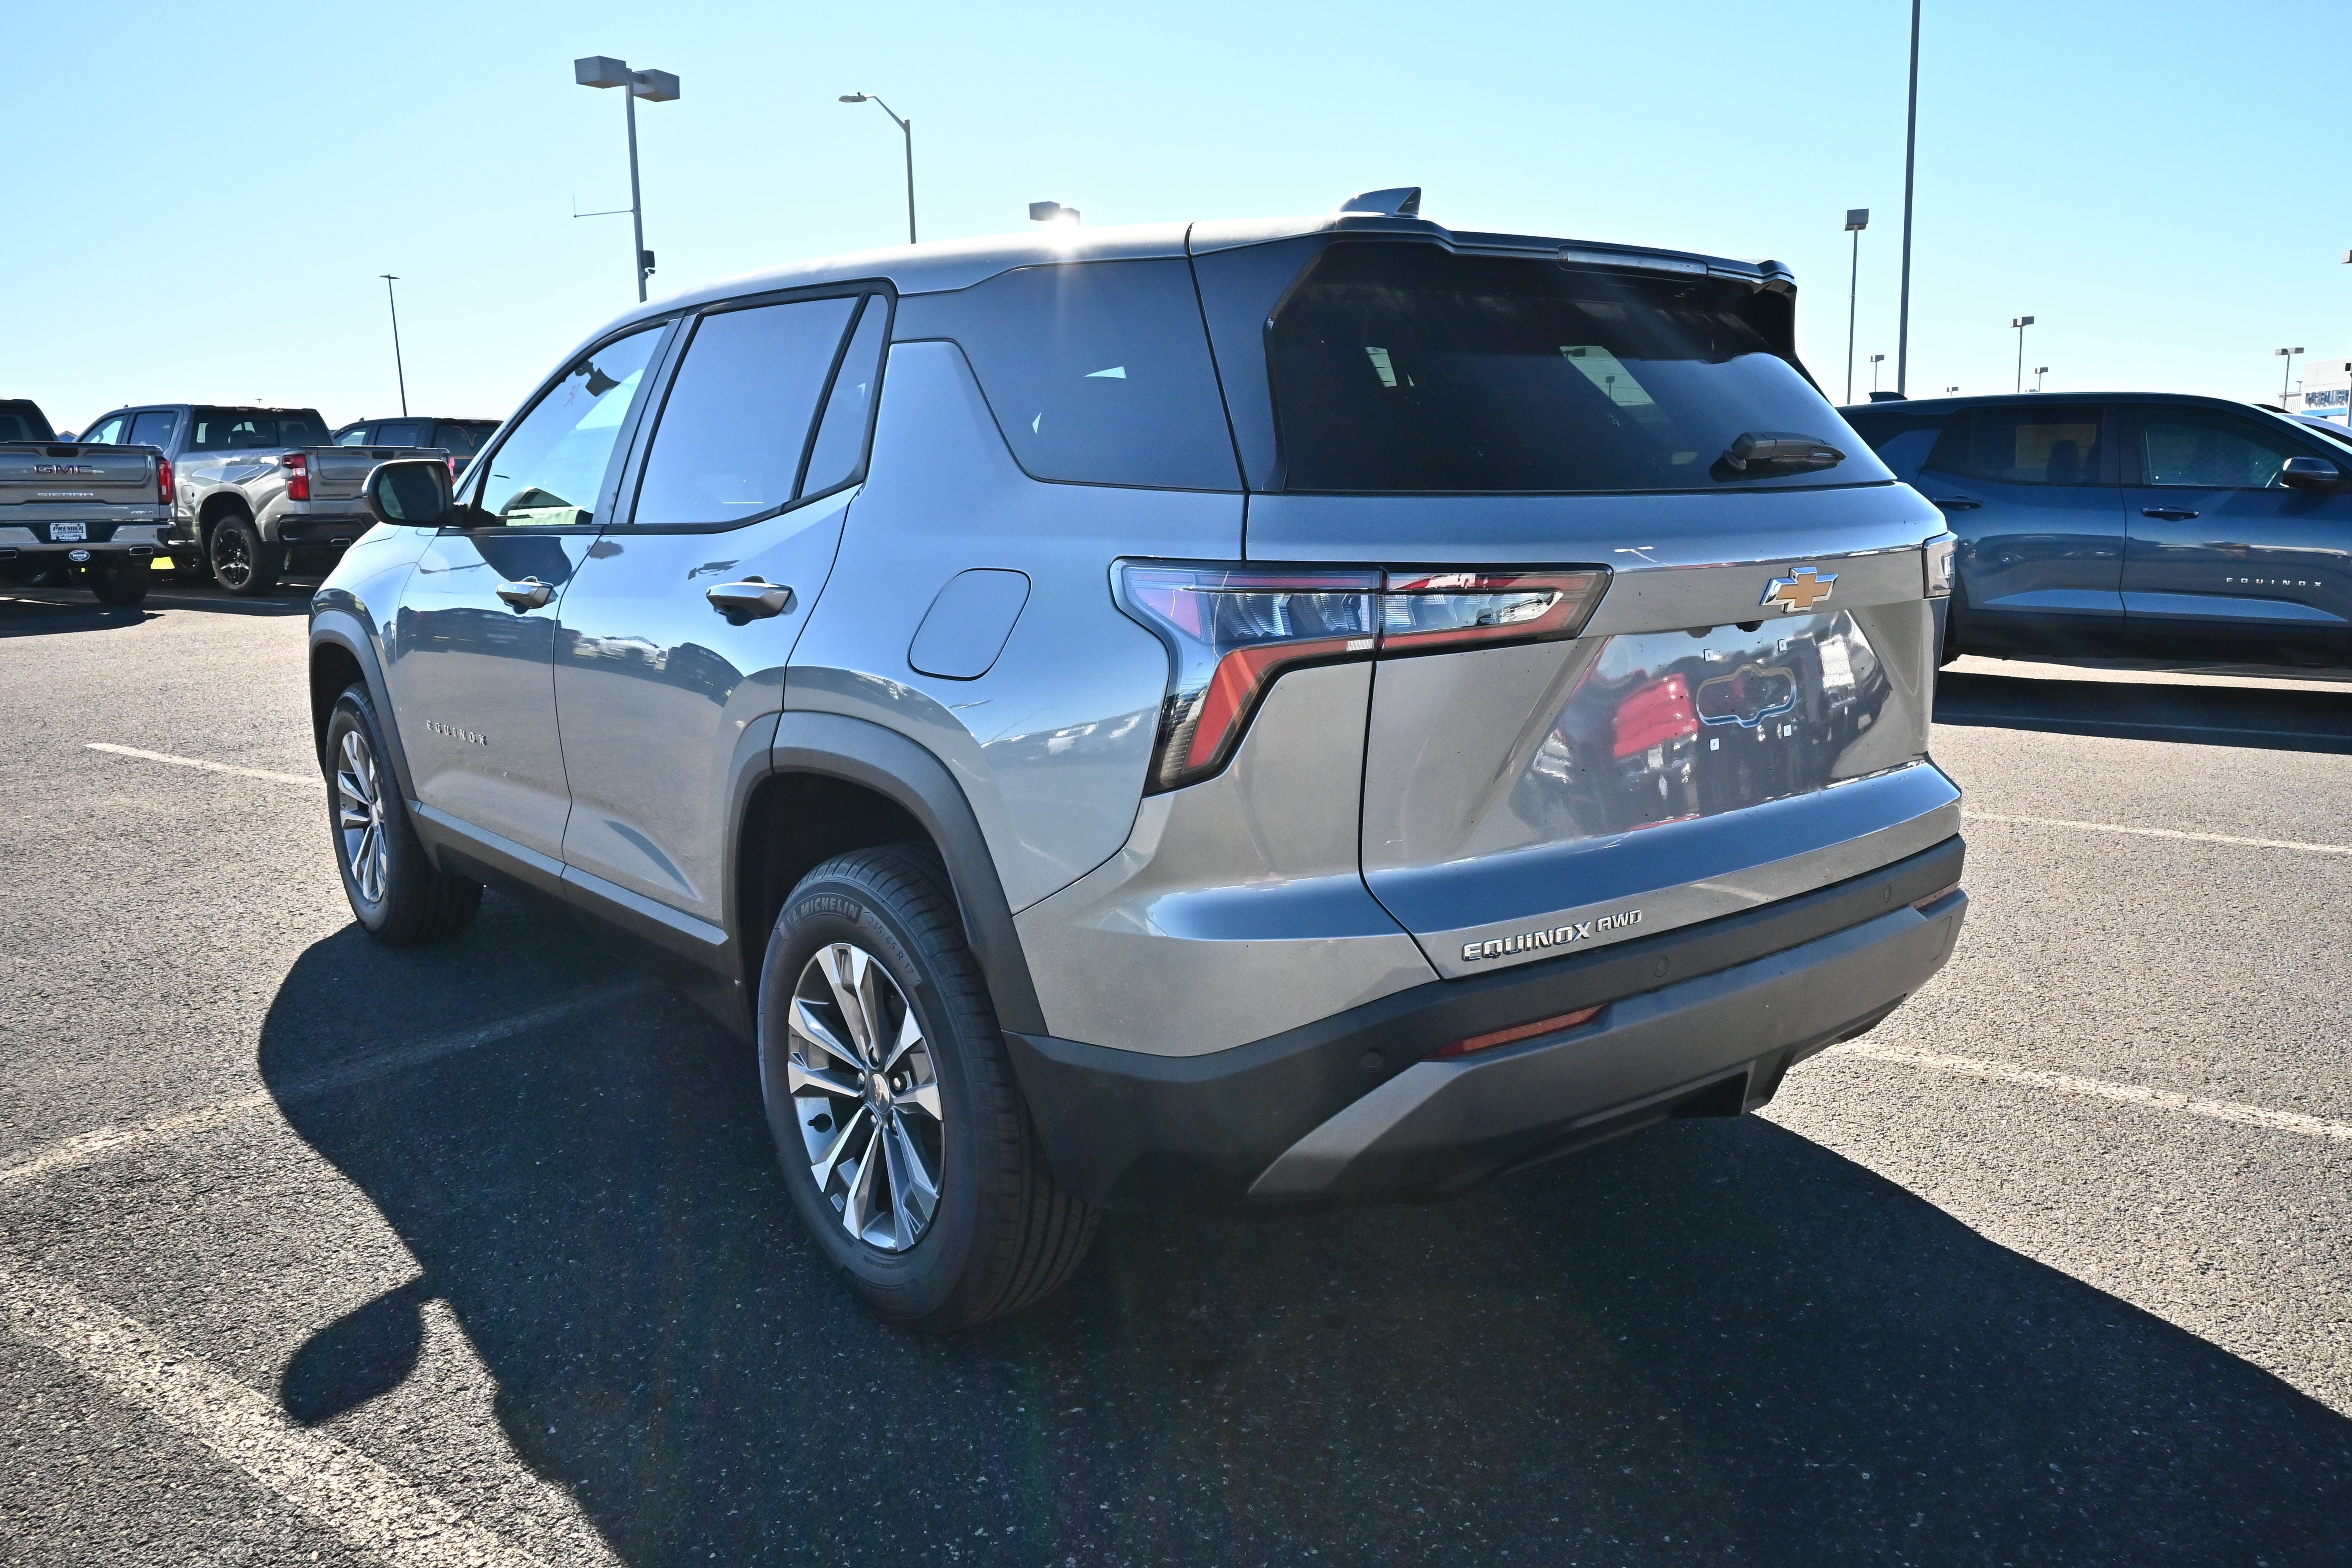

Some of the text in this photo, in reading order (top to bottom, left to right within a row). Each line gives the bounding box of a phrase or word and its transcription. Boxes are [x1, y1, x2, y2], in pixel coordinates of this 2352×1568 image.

[34, 465, 93, 474] GMC
[2226, 577, 2322, 587] EQUINOX
[426, 720, 487, 746] EQUINOX
[800, 897, 858, 918] MICHELIN
[867, 917, 914, 974] 235/65 R 17
[1462, 909, 1642, 962] EQUINOX AWD
